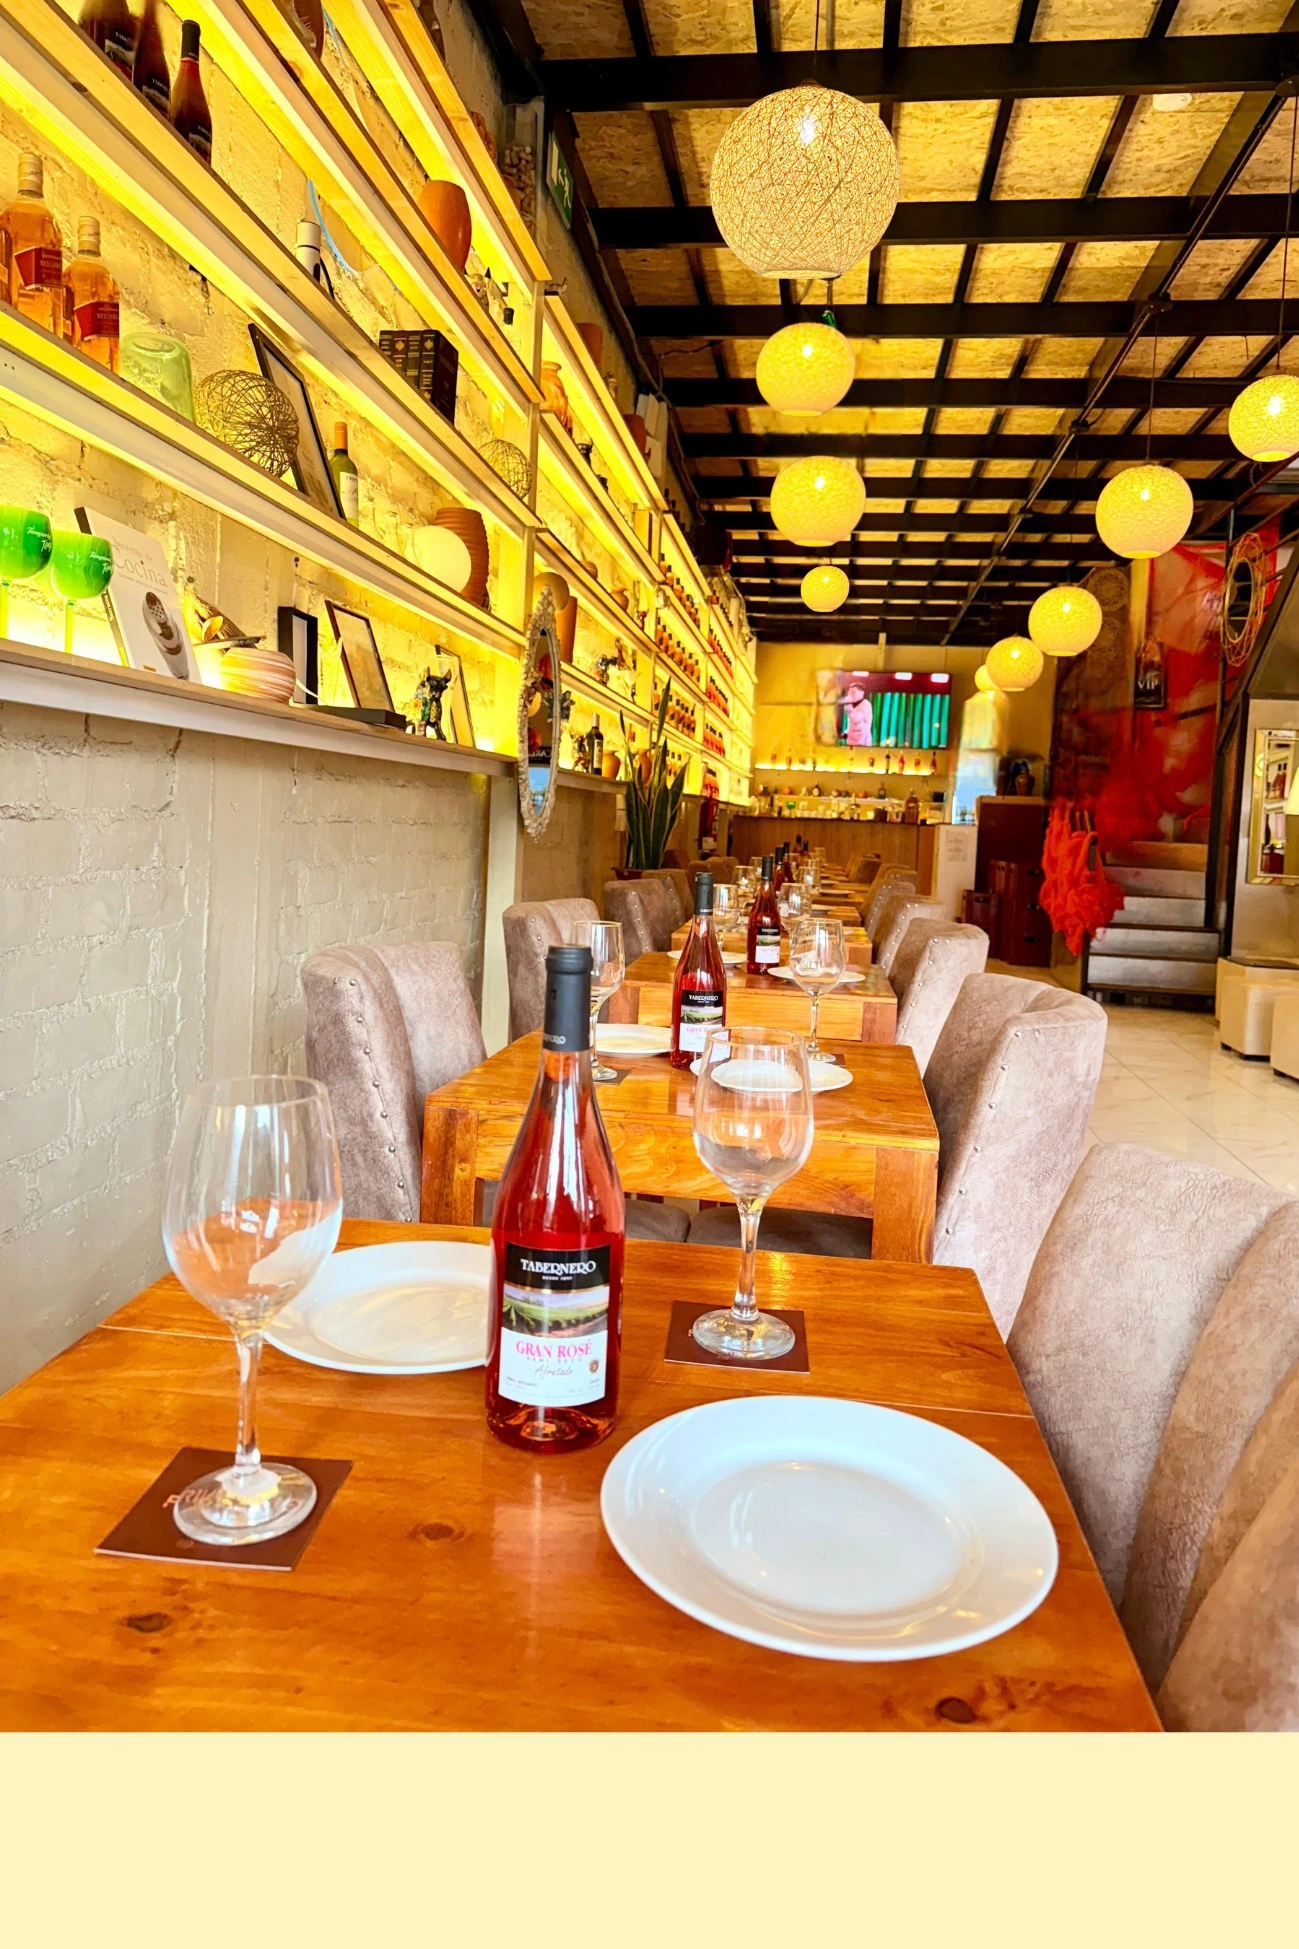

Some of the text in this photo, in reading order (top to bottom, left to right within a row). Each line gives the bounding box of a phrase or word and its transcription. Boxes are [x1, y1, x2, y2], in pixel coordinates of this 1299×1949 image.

[1138, 681, 1158, 690] VIP
[520, 1259, 597, 1276] TABERNERO
[516, 1338, 592, 1358] GRAN ROSÉ
[534, 1364, 574, 1380] Afrutado
